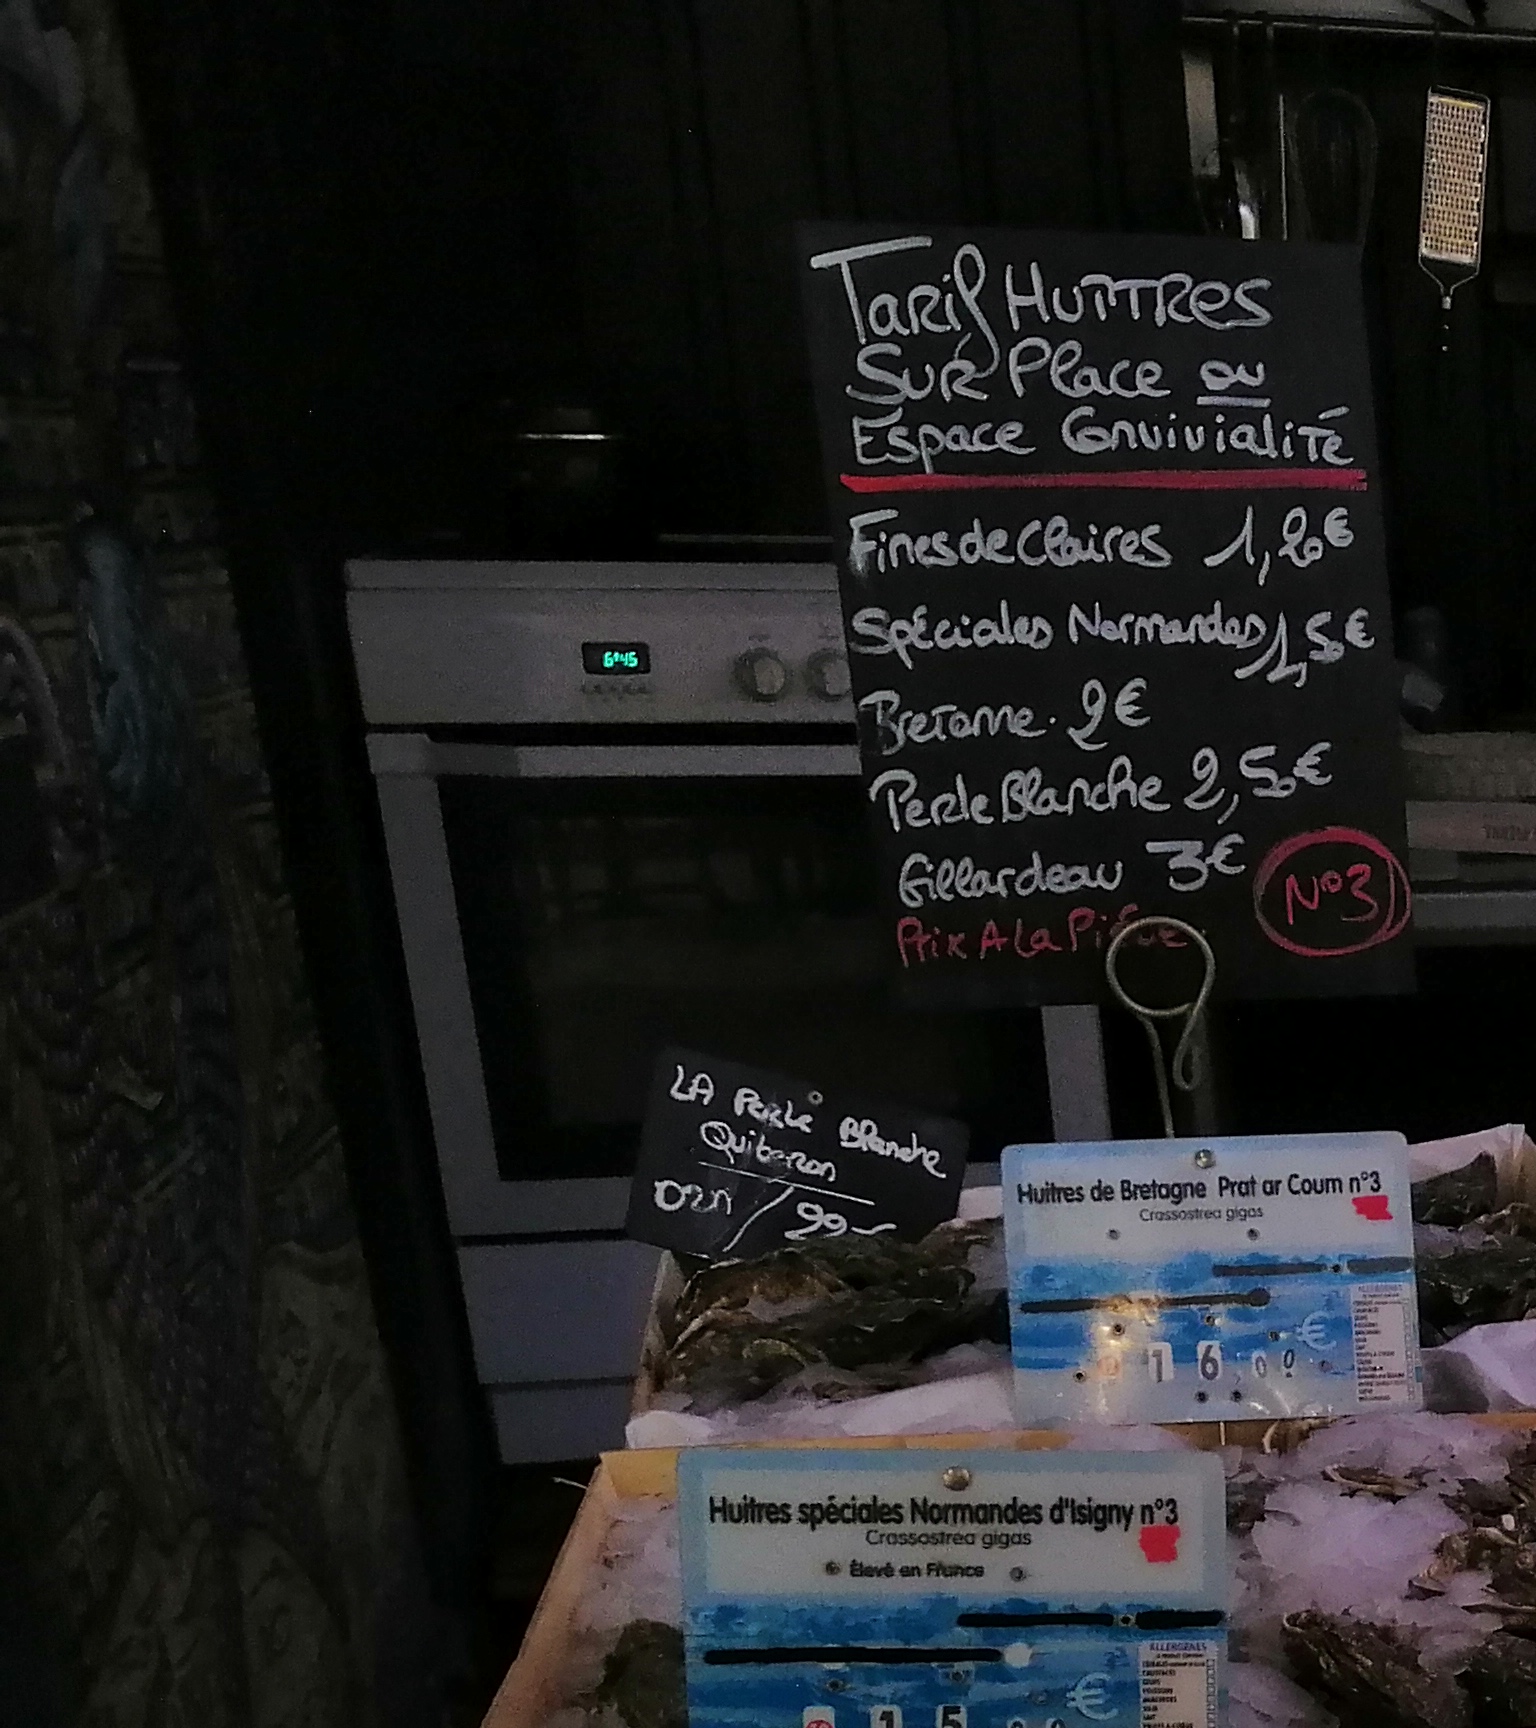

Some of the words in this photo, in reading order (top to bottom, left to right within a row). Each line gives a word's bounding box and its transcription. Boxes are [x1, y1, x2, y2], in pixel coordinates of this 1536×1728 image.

[811, 236, 999, 378] Tarif
[1009, 337, 1171, 398] Place
[852, 406, 1036, 474] Espace
[848, 600, 1053, 669] Spéciales
[1068, 600, 1267, 649] Normandes
[1002, 755, 1170, 823] Blanche
[1017, 1181, 1085, 1204] Huitres
[1090, 1179, 1115, 1201] de
[1120, 1177, 1206, 1205] Bretagne
[1218, 1175, 1259, 1199] Prat
[1262, 1179, 1283, 1197] ar
[1287, 1172, 1343, 1195] Coum
[1348, 1170, 1382, 1194] n°3
[1139, 1207, 1222, 1222] Crassostrea
[1226, 1205, 1264, 1223] gigas
[708, 1496, 792, 1526] Huitres
[797, 1496, 904, 1530] spéciales
[910, 1496, 1043, 1526] Normandes
[1050, 1495, 1134, 1531] d'Isigny
[1139, 1498, 1178, 1525] n°3
[865, 1528, 976, 1547] Crassostrea
[981, 1528, 1032, 1550] gigas
[899, 1564, 922, 1579] en
[926, 1561, 985, 1580] France
